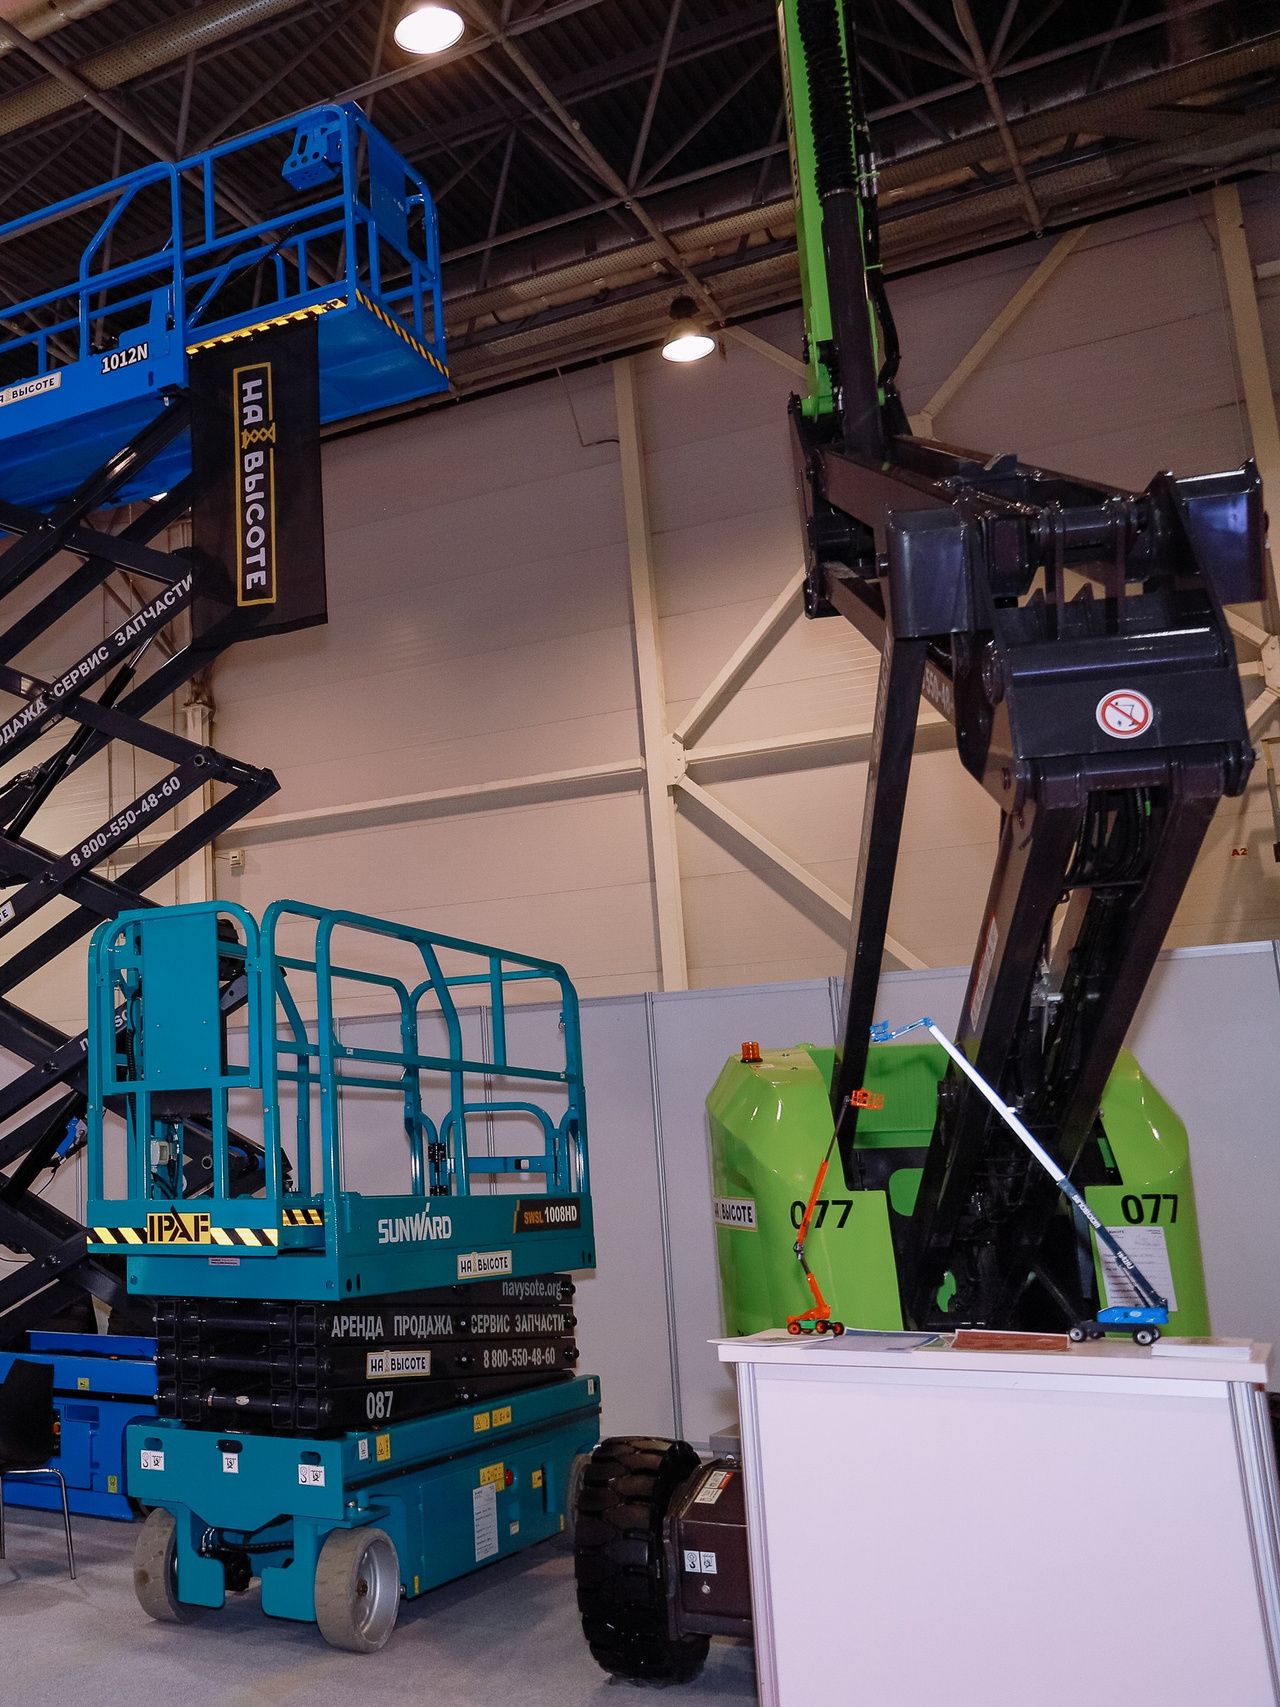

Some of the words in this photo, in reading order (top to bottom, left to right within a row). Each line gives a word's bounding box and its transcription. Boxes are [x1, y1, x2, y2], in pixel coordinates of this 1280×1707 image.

[101, 343, 149, 375] 1012N
[11, 378, 56, 399] ВЫСОТЕ
[242, 379, 263, 426] НА
[244, 451, 266, 590] ВЫСОТЕ
[52, 646, 110, 698] СЕРВИС
[114, 573, 193, 648] ЗАПЧАСТИ
[70, 853, 82, 868] 8
[81, 776, 182, 860] 800-550-48-60
[149, 1205, 209, 1242] IPAF
[378, 1203, 452, 1244] SUNWARD
[523, 1211, 544, 1225] SWSL
[544, 1205, 578, 1223] 1008HD
[790, 1200, 853, 1230] 077
[1121, 1194, 1178, 1224] 077
[460, 1260, 472, 1273] НА
[477, 1256, 508, 1271] ВЫСОТЕ
[502, 1281, 563, 1300] navysote.org
[331, 1315, 384, 1341] АРЕНДА
[393, 1315, 454, 1339] ПРОДАЖА
[471, 1314, 510, 1334] СЕРВИС
[515, 1313, 566, 1332] ЗАПЧАСТИ
[370, 1358, 384, 1372] НА
[390, 1356, 426, 1371] ВЫСОТЕ
[483, 1350, 489, 1368] 8
[491, 1347, 555, 1367] 800-550-48-60
[366, 1390, 394, 1420] 087
